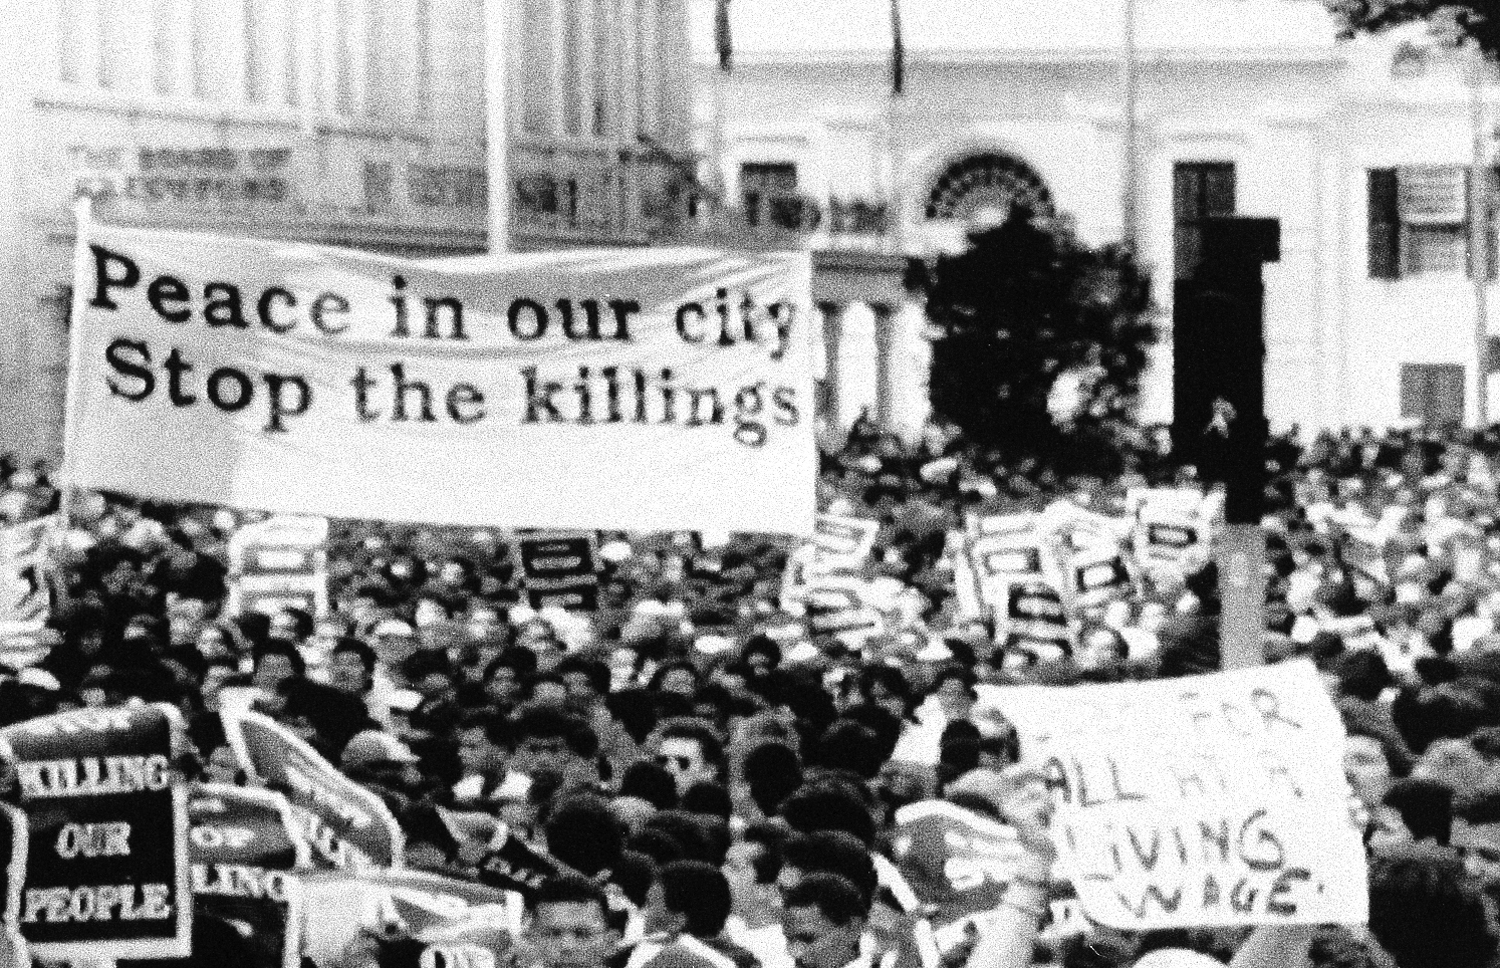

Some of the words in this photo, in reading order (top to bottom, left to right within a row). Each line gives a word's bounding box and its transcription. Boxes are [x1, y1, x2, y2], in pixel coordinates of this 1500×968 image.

[88, 244, 351, 334] Peace
[390, 274, 468, 340] in
[506, 297, 642, 342] our
[675, 286, 797, 361] city
[104, 337, 313, 433] Stop
[350, 362, 487, 423] the
[518, 365, 801, 448] killings
[17, 755, 169, 800] KILLING
[54, 821, 132, 860] OUR
[20, 884, 171, 924] PEOPLE
[191, 863, 288, 903] LING
